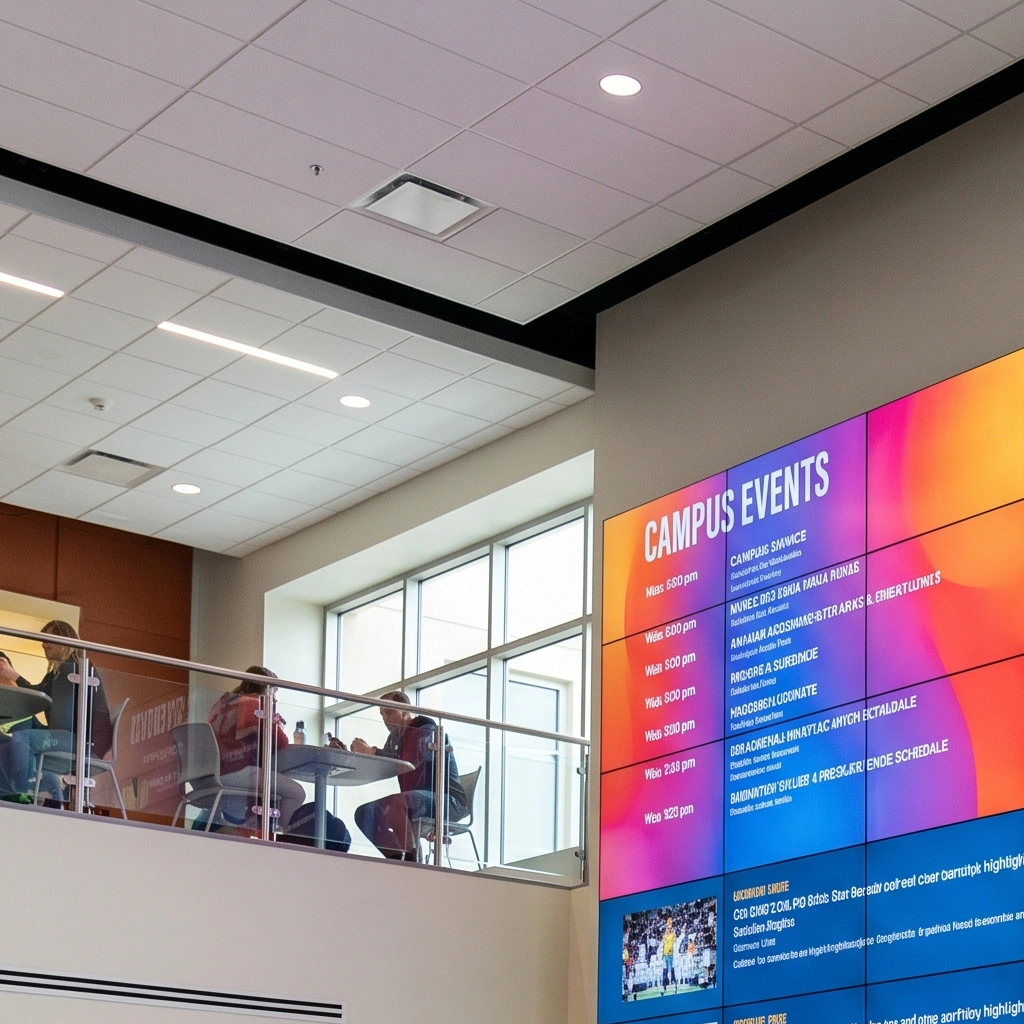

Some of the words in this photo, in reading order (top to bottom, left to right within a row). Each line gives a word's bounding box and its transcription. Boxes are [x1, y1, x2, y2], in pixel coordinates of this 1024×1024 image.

[644, 488, 734, 562] CAMPUS
[741, 450, 830, 527] EVENTS
[684, 571, 698, 587] pm
[683, 619, 697, 635] pm
[682, 652, 696, 668] pm
[682, 685, 696, 701] pm
[681, 719, 695, 735] pm
